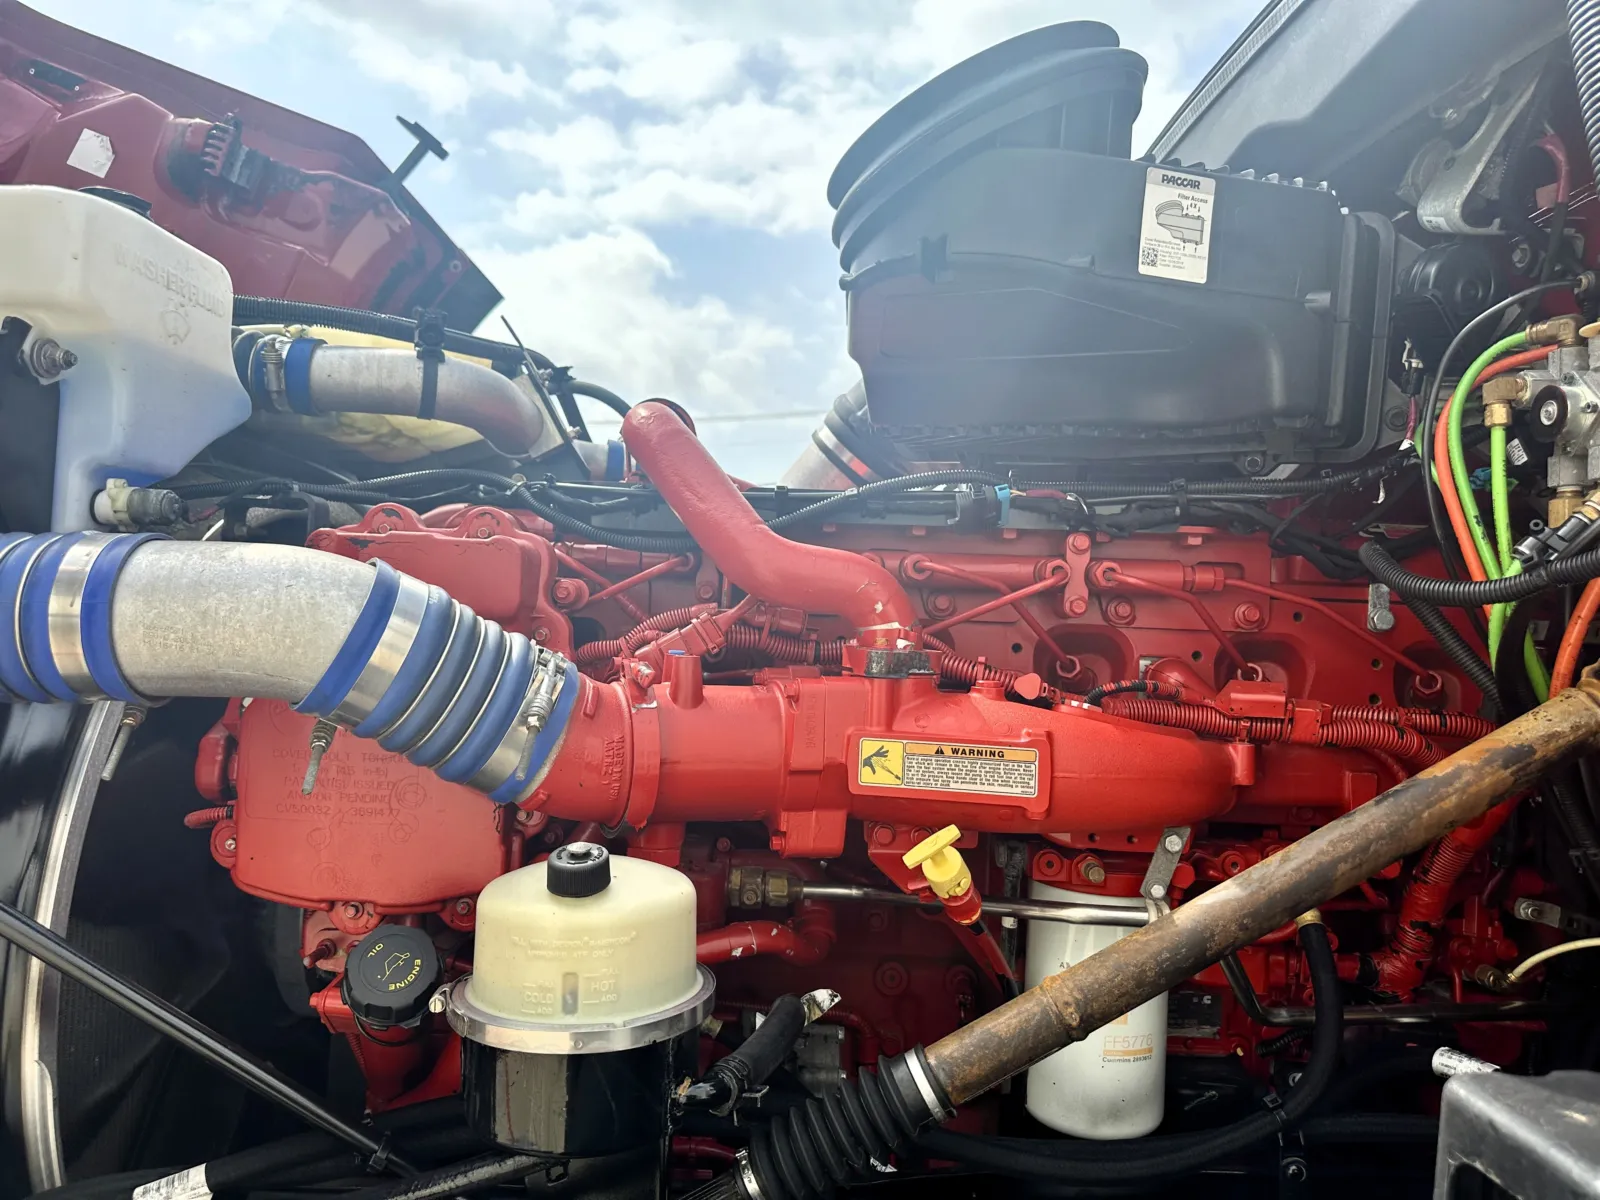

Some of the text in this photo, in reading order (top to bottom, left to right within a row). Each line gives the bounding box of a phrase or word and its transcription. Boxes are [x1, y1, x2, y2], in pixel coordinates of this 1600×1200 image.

[1161, 174, 1200, 190] PACCAR
[1190, 196, 1208, 204] Access
[115, 243, 225, 318] WASHER FLUID
[272, 748, 311, 760] COVE
[951, 748, 1005, 758] WARNING
[353, 780, 395, 790] ISSUED
[339, 793, 390, 804] PENDING
[367, 943, 384, 958] OIL
[388, 959, 421, 990] ENGINE
[591, 980, 616, 992] HOT
[524, 991, 554, 1004] COLD
[1104, 1033, 1153, 1048] FF5776
